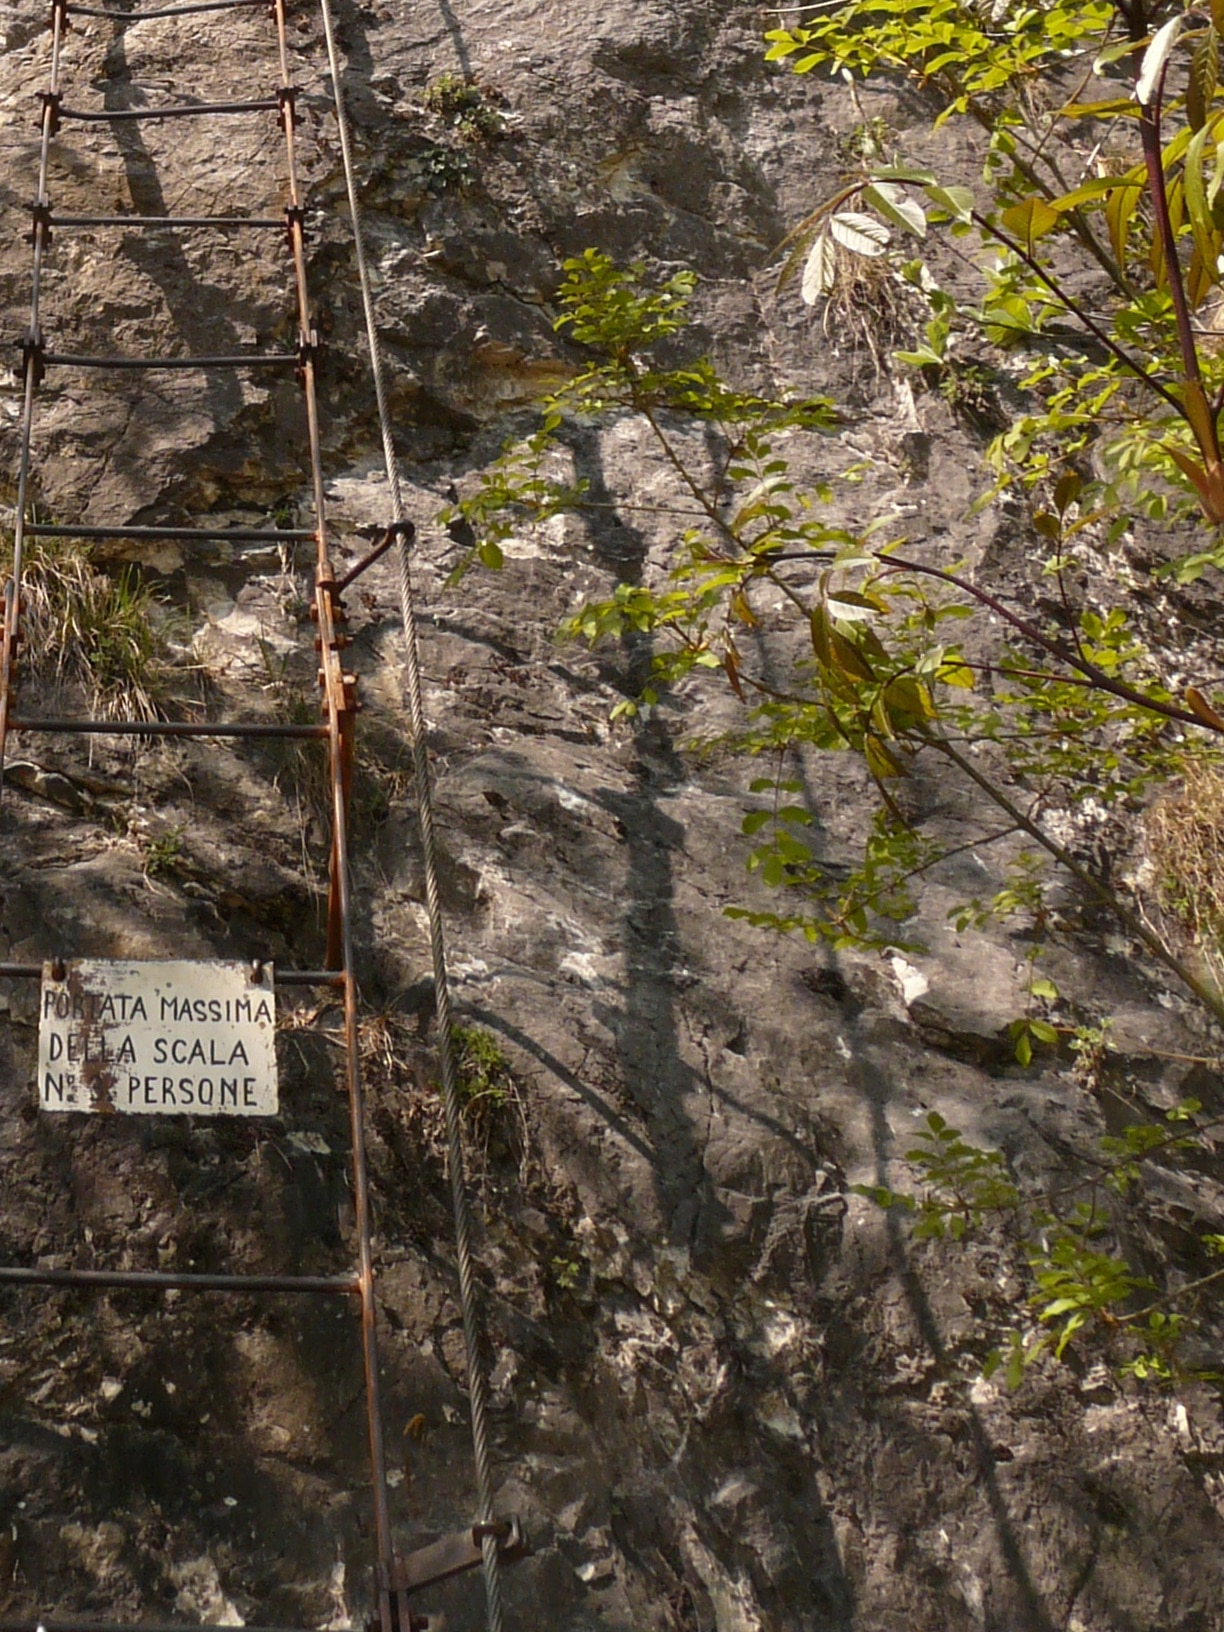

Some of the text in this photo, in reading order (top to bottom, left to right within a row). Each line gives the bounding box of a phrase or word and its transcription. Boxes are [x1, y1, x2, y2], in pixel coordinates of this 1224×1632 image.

[43, 989, 273, 1024] PORTATA MASSIMA
[49, 1032, 250, 1066] DELLA SCALA
[128, 1076, 258, 1107] PERSONE
